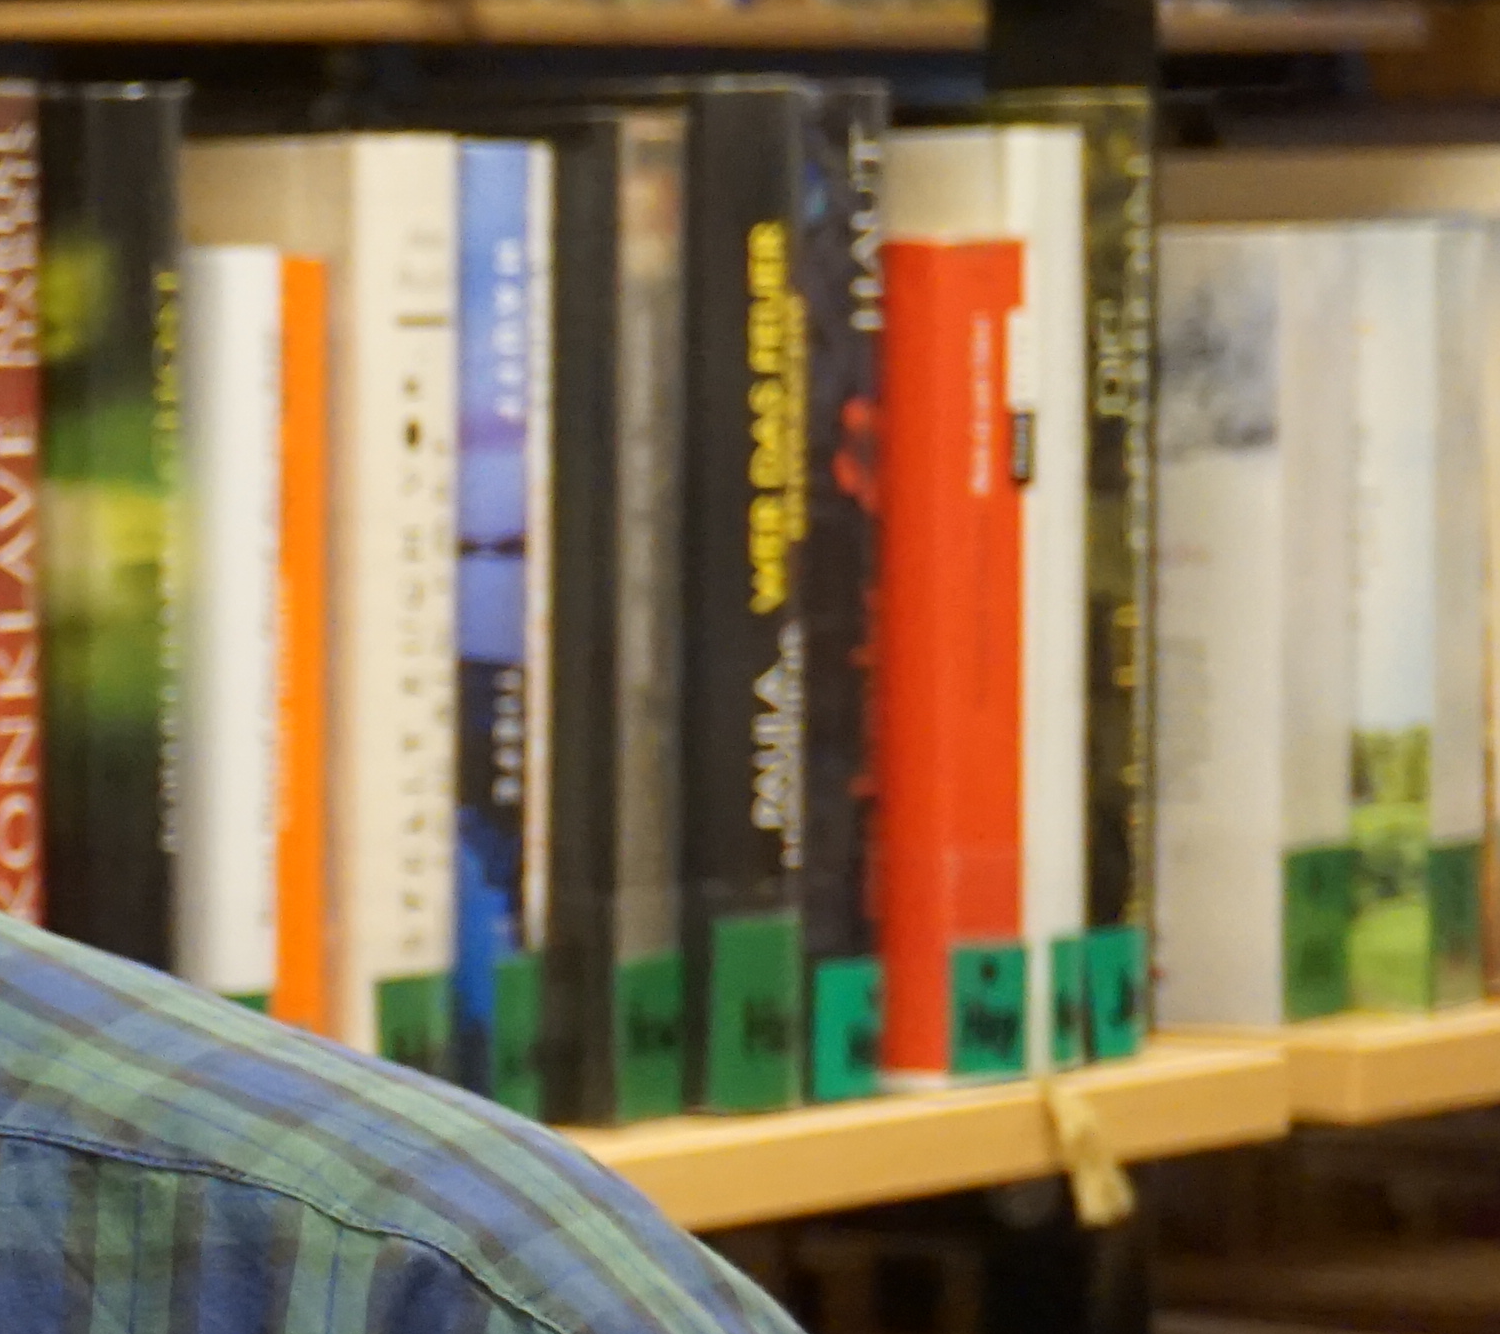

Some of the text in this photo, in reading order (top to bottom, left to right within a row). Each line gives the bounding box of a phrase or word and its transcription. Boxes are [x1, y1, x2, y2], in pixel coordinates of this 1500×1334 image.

[847, 123, 886, 332] HAUT
[747, 219, 788, 829] PAULA WER DAS FEUER
